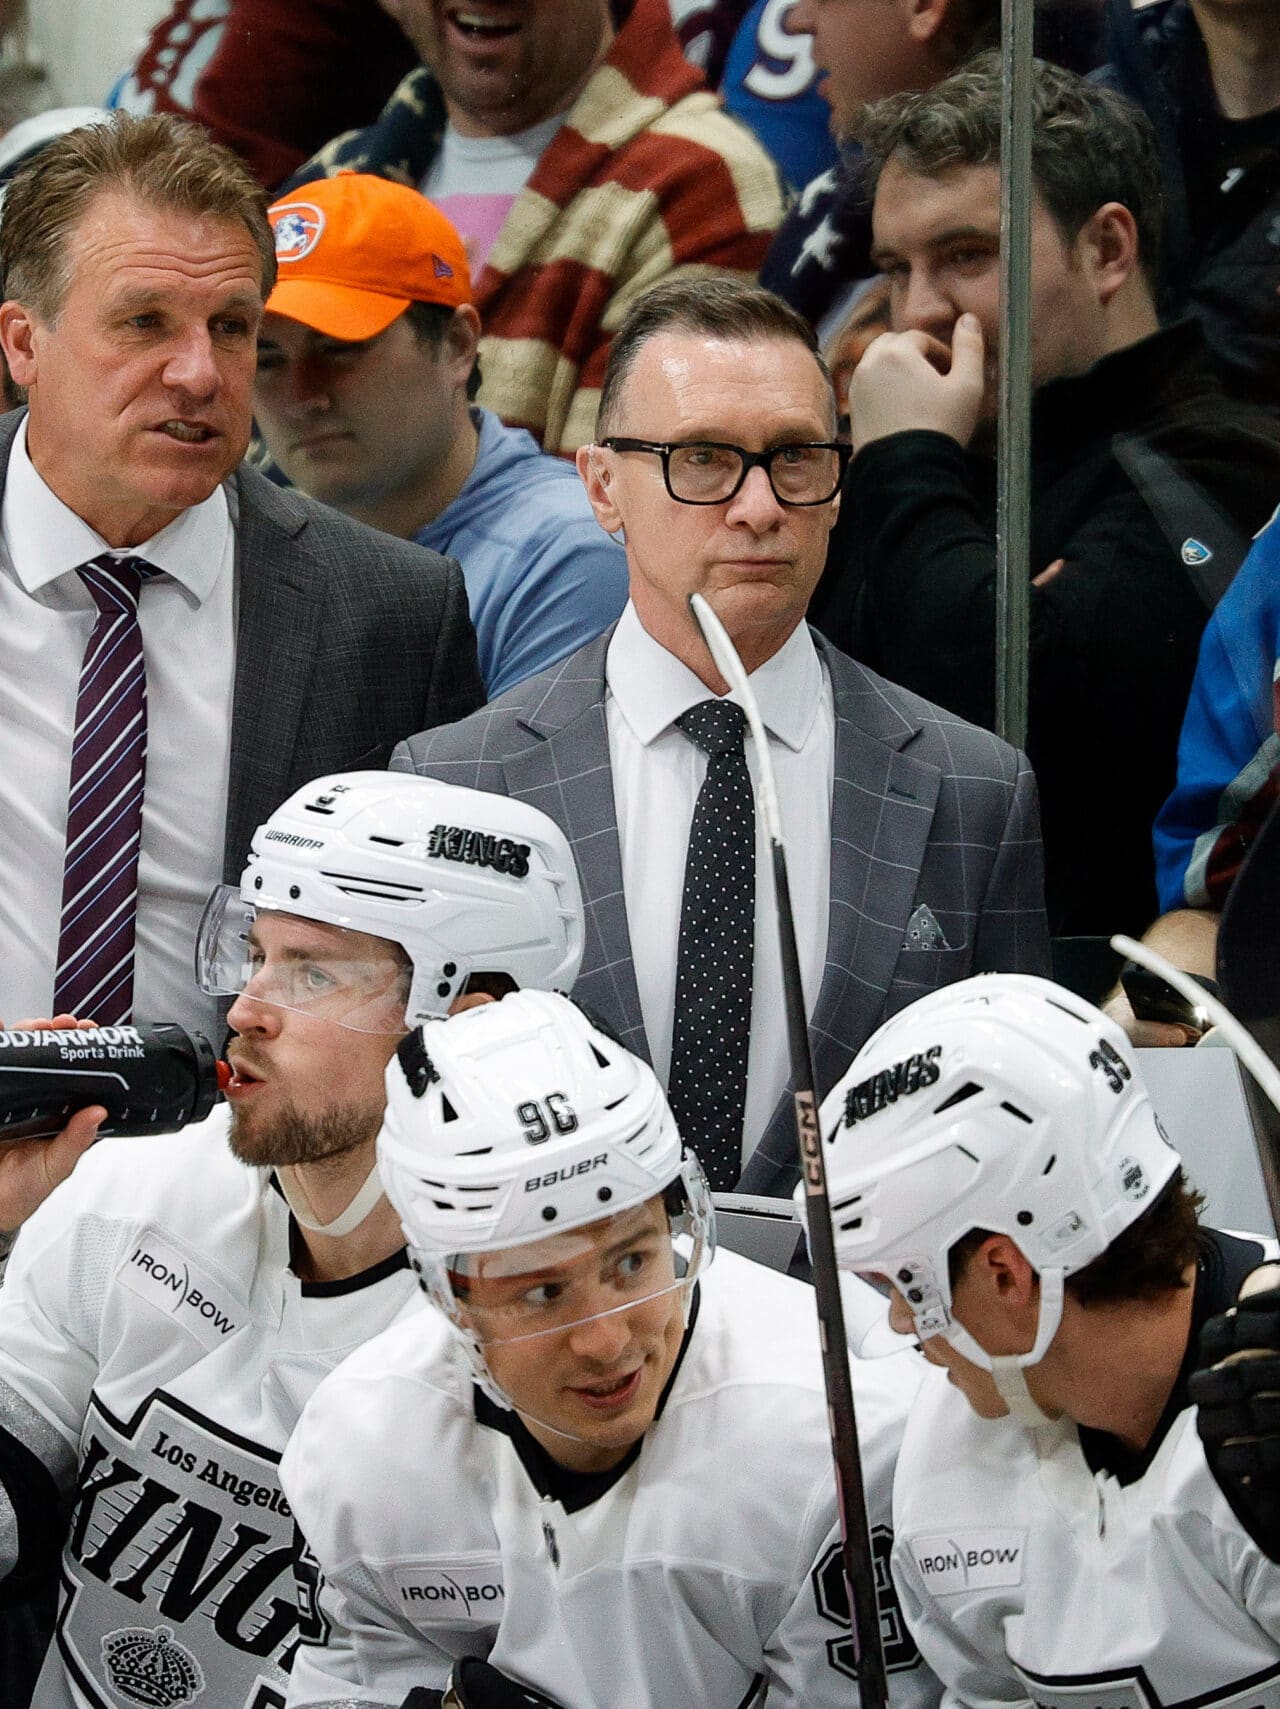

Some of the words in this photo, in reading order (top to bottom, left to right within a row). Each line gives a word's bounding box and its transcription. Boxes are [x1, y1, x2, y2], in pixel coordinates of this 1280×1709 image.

[425, 824, 531, 879] KINGS
[60, 1045, 106, 1062] Sports
[108, 1045, 145, 1060] Drink
[514, 1090, 579, 1146] 96
[524, 1152, 608, 1193] BAUER
[130, 1248, 184, 1292] IRON
[185, 1288, 236, 1335] BOW
[151, 1430, 198, 1473] Los
[196, 1459, 294, 1518] Angele
[70, 1434, 300, 1674] KING
[919, 1554, 958, 1575] IRON
[966, 1548, 1019, 1567] BOW
[401, 1585, 457, 1601] IRON
